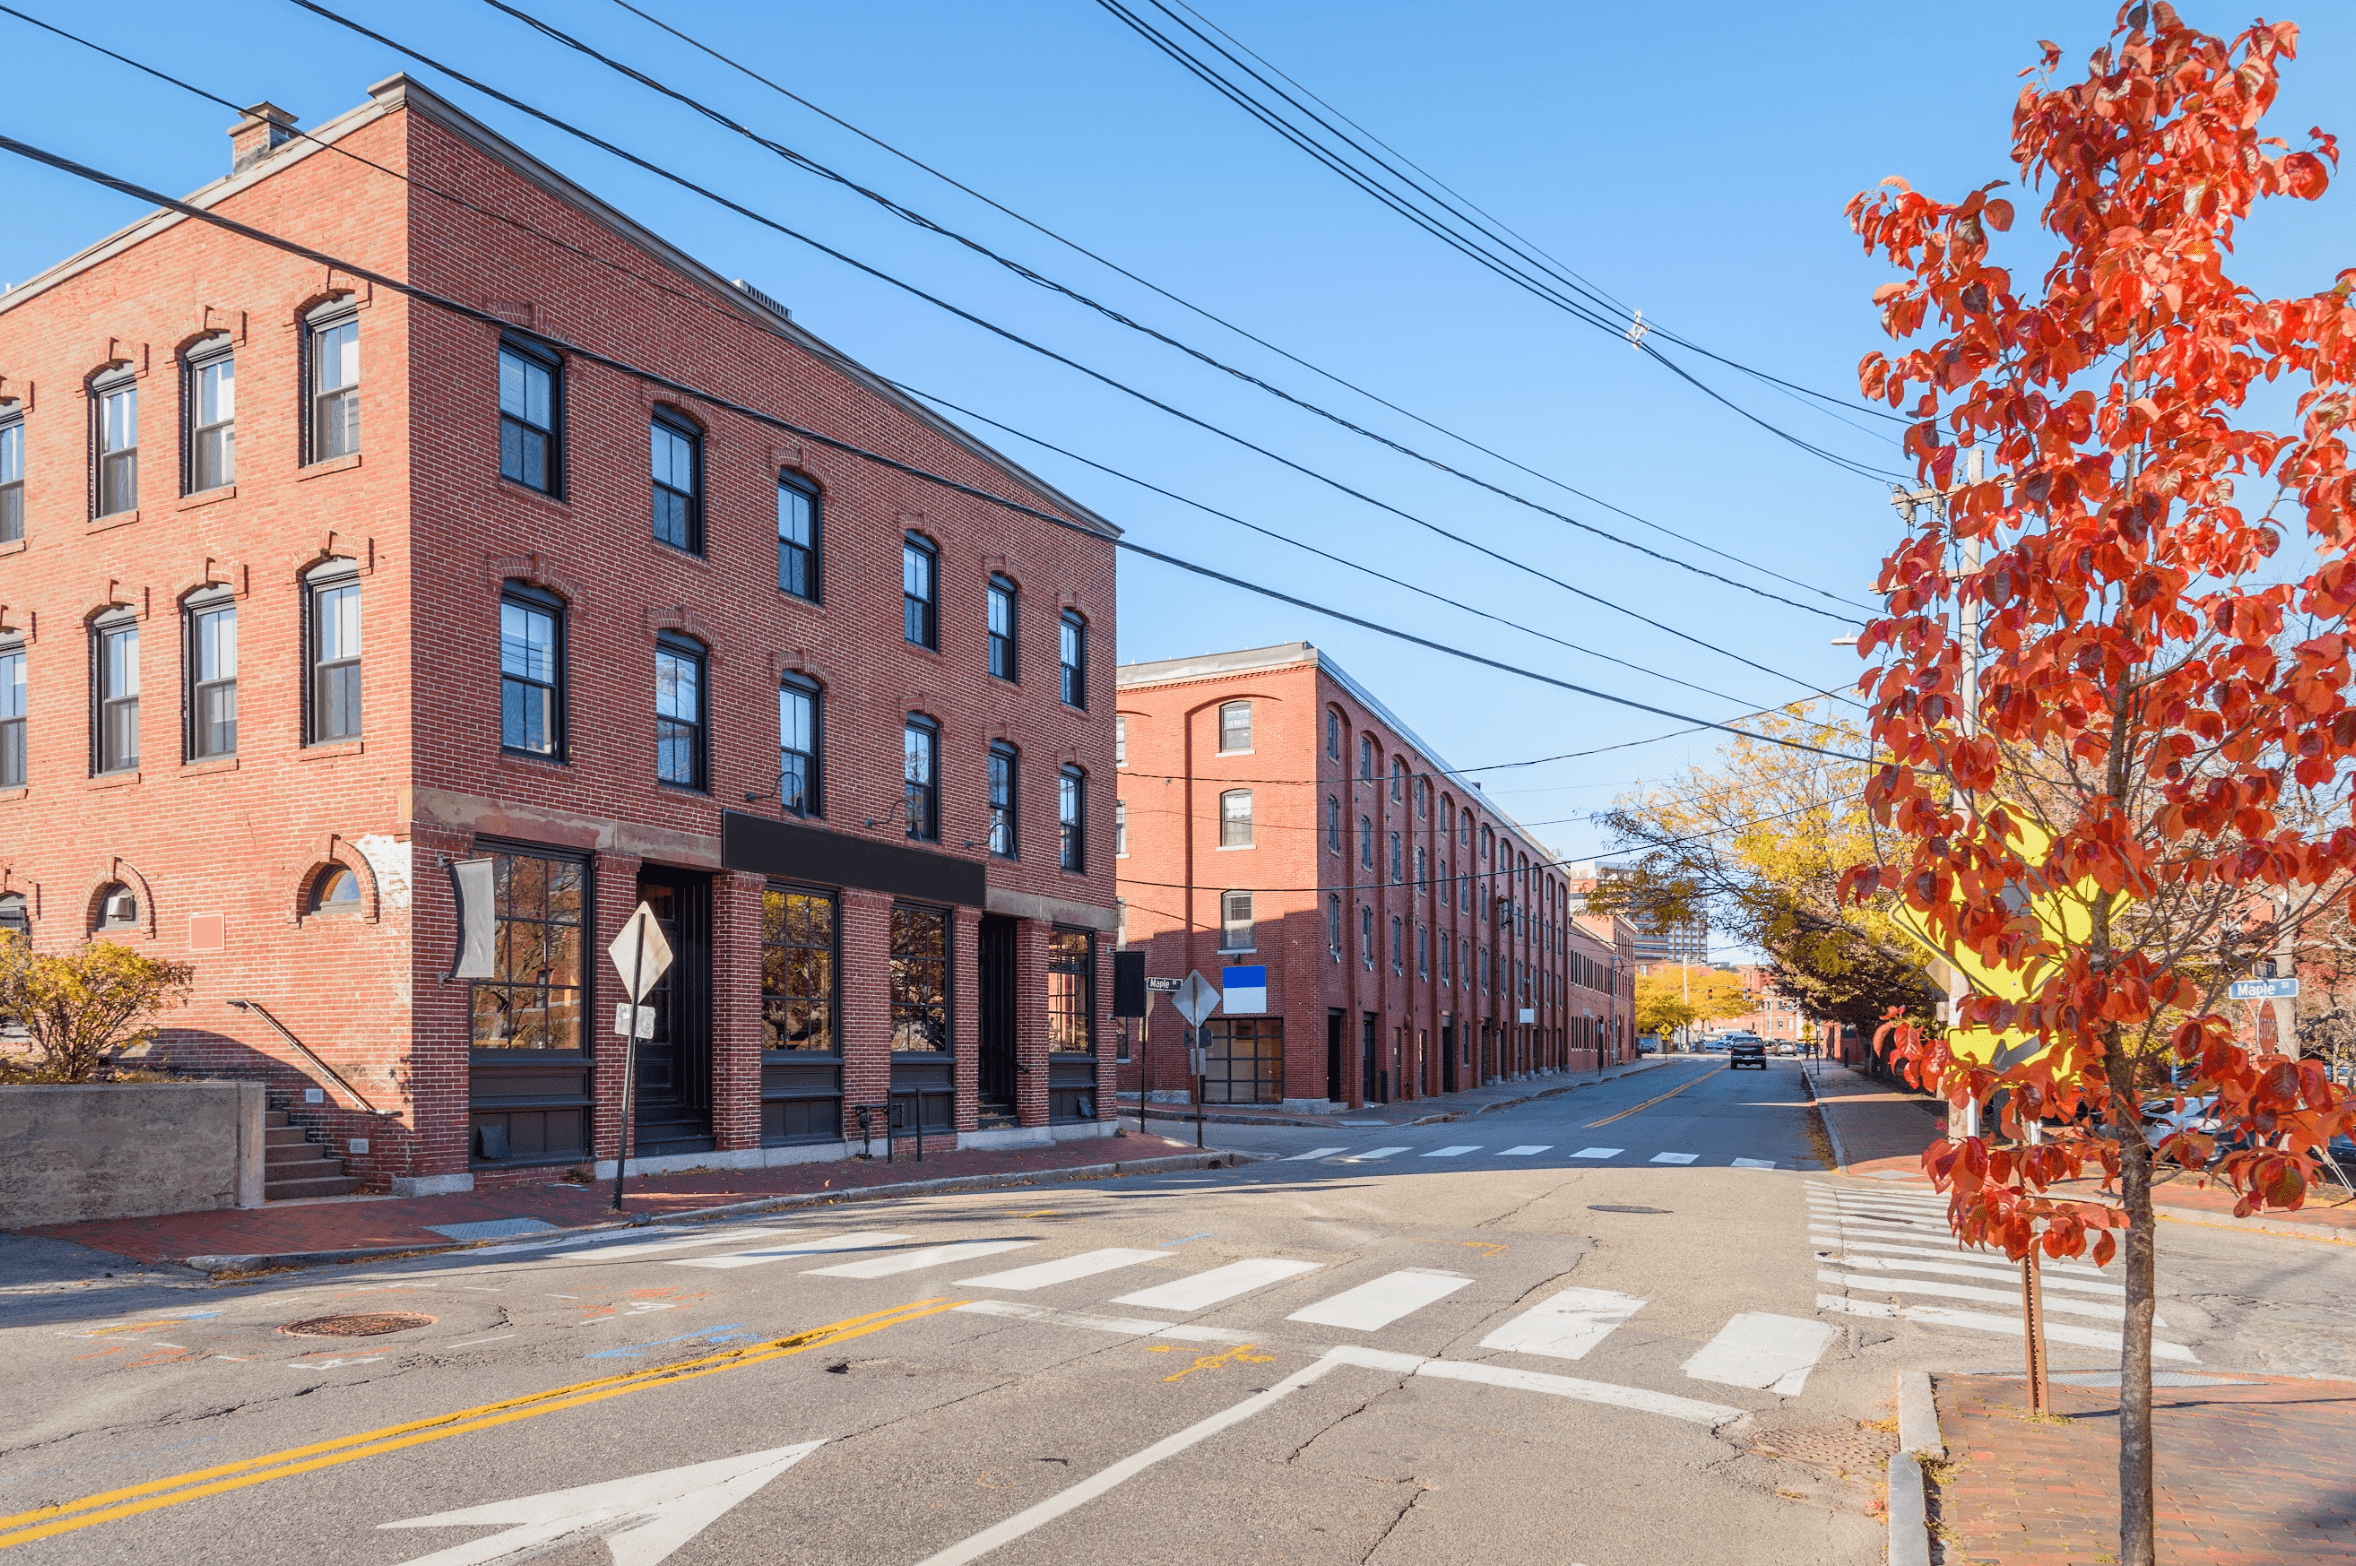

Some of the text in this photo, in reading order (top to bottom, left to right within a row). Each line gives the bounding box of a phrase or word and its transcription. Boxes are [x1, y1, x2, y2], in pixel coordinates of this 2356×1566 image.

[1150, 978, 1170, 989] Maple
[2237, 983, 2275, 997] Maple
[2259, 1018, 2276, 1040] STOP
